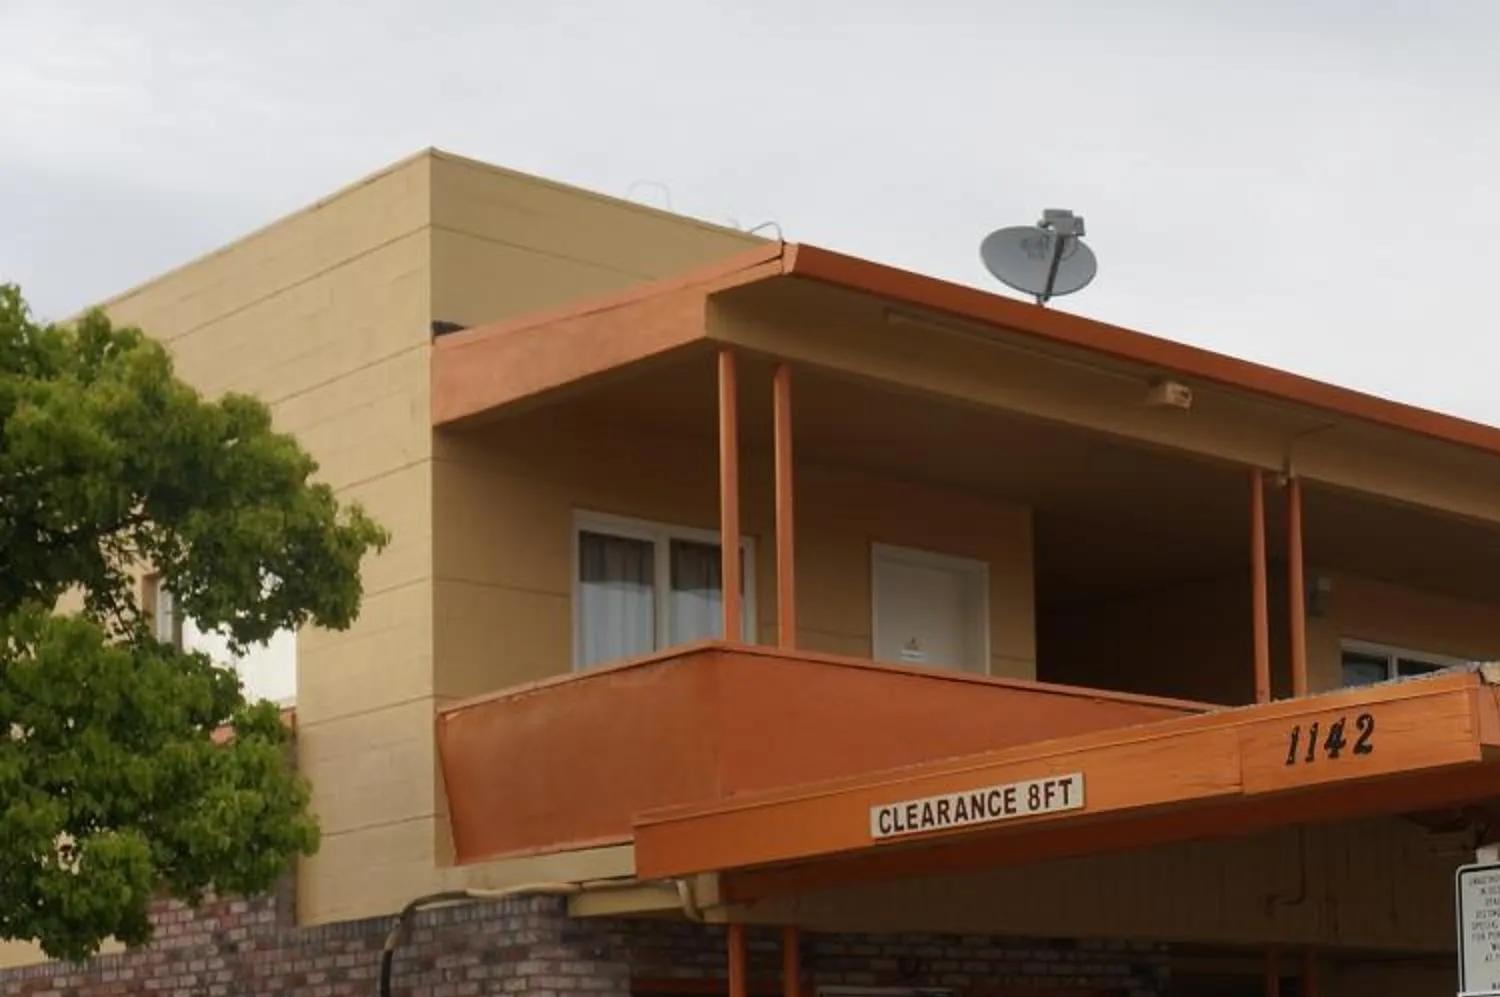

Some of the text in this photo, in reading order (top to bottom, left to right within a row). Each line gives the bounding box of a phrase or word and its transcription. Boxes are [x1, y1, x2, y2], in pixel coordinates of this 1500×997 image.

[1285, 714, 1375, 766] 1142
[878, 777, 1074, 836] CLEARANCE 8FT
